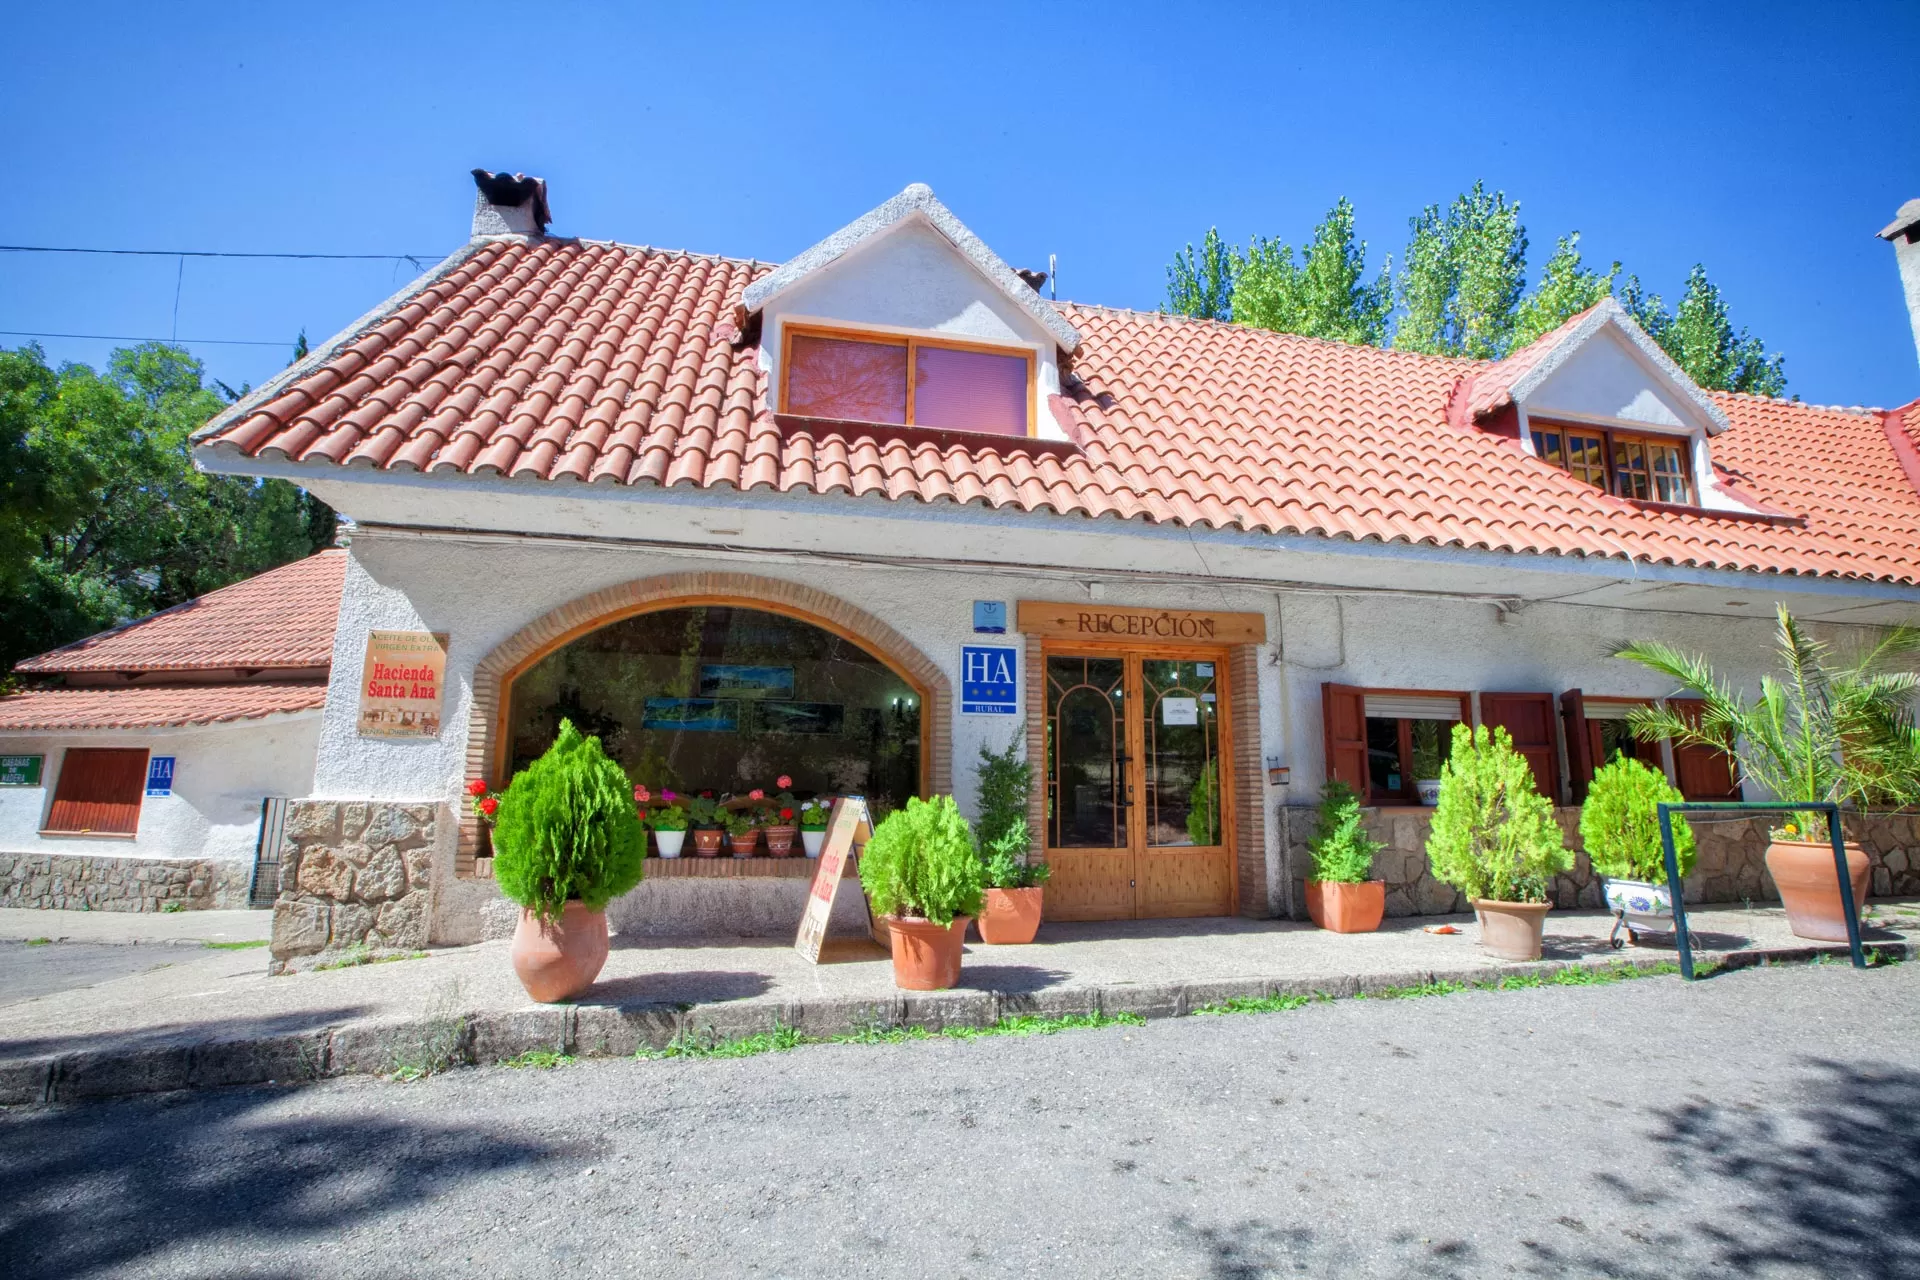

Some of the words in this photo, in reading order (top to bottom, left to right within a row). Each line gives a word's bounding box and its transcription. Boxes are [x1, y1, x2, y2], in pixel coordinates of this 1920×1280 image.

[1077, 612, 1215, 638] RECEPCIÓN
[370, 633, 402, 642] ACEITE
[420, 635, 445, 643] OLIVA
[375, 643, 407, 651] VIRGEN
[410, 644, 439, 652] EXTRA
[373, 663, 434, 682] Hacienda
[964, 652, 1014, 684] HA
[367, 680, 406, 699] Santa
[410, 682, 436, 700] Ana
[975, 704, 1005, 713] RURAL
[150, 759, 172, 779] HA
